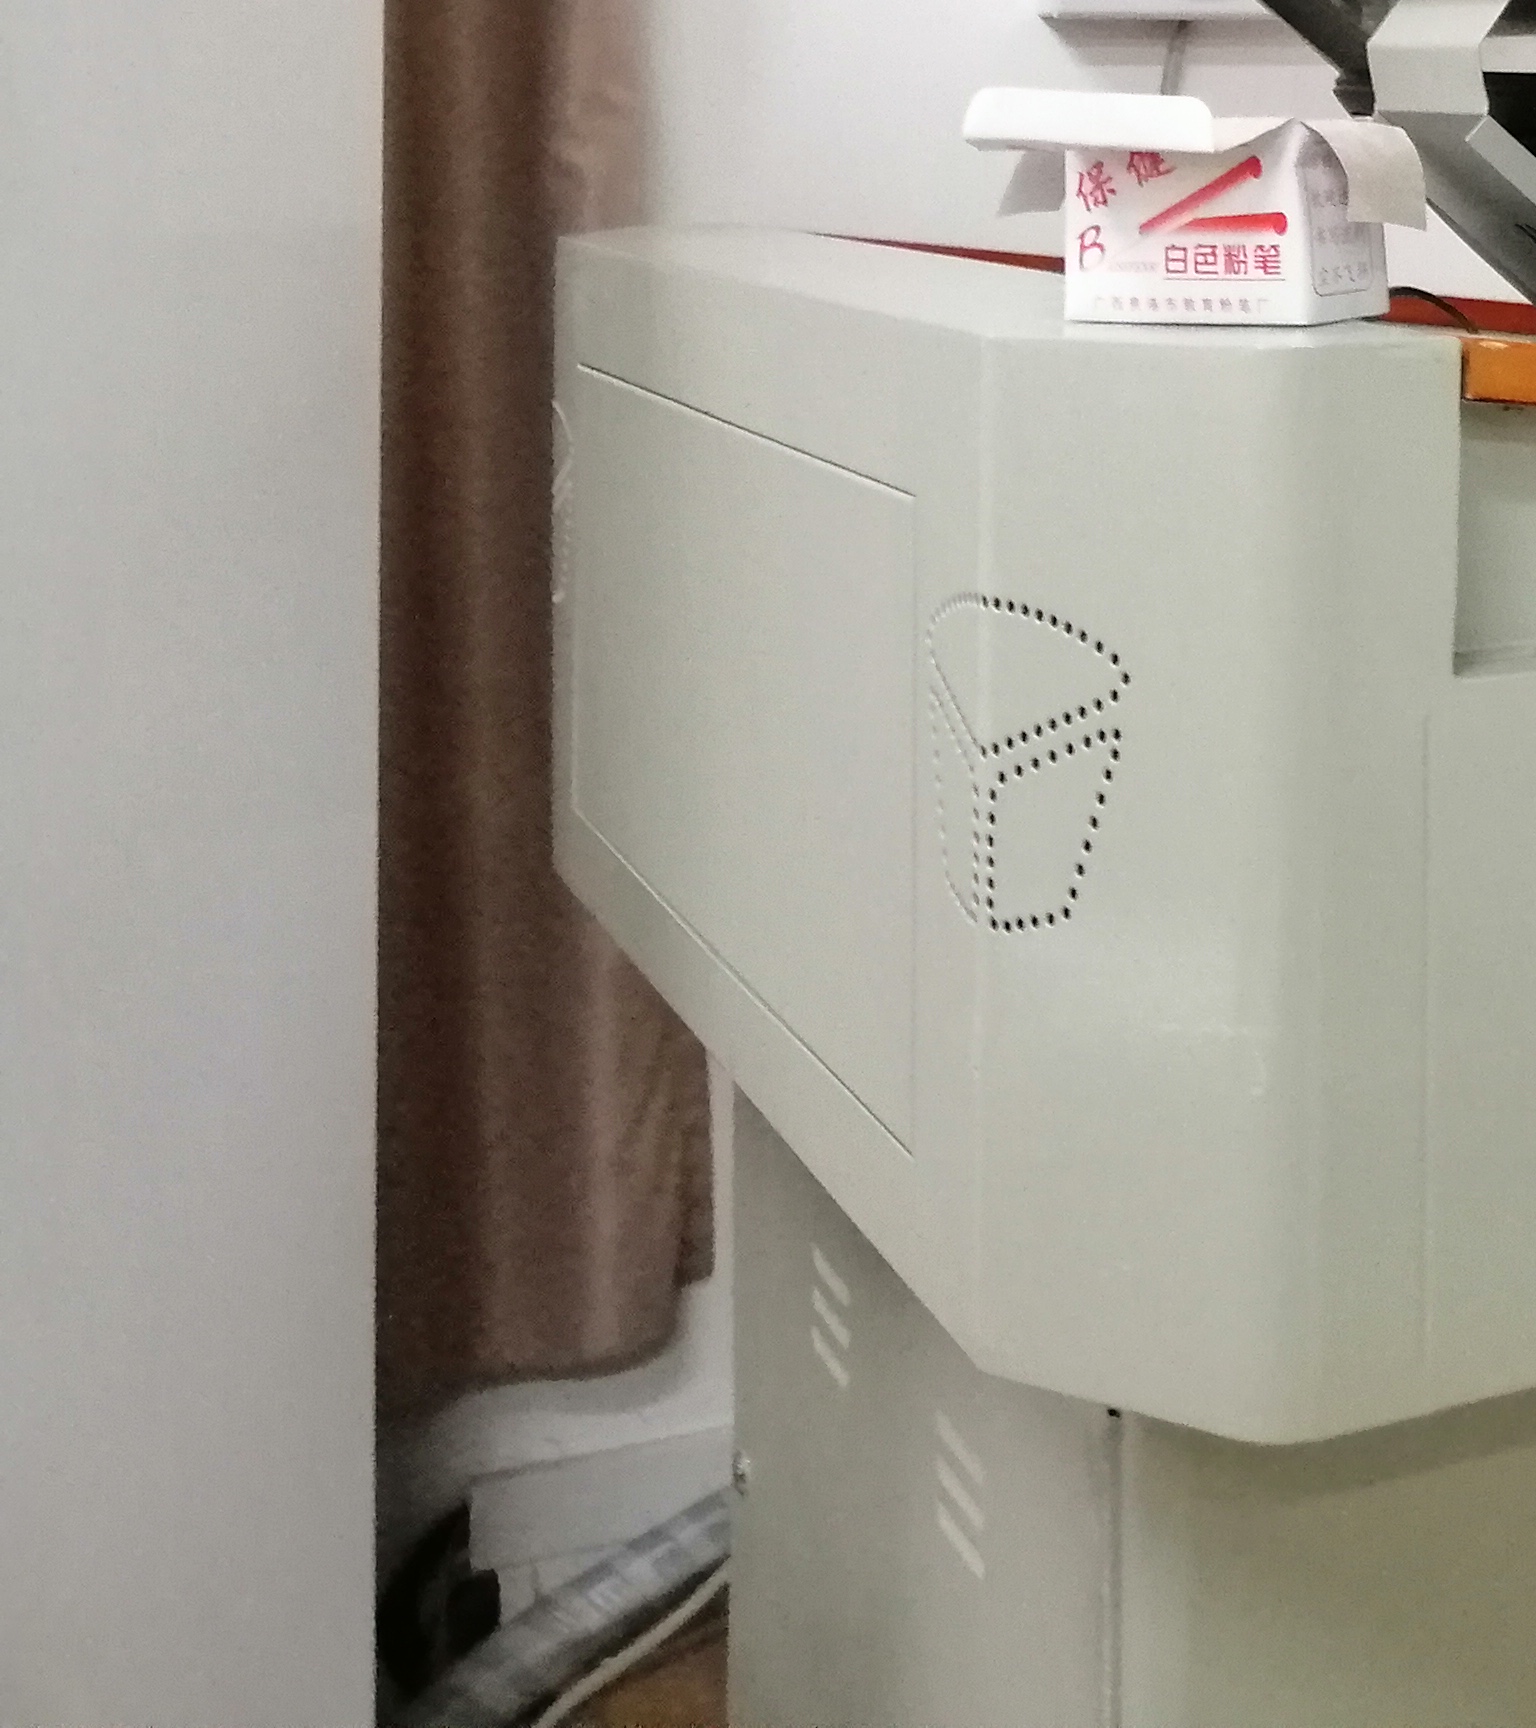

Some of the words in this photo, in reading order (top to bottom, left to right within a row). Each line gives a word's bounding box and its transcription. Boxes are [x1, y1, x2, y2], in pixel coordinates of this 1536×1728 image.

[1077, 225, 1106, 272] B
[1164, 243, 1282, 276] 白色粉笔
